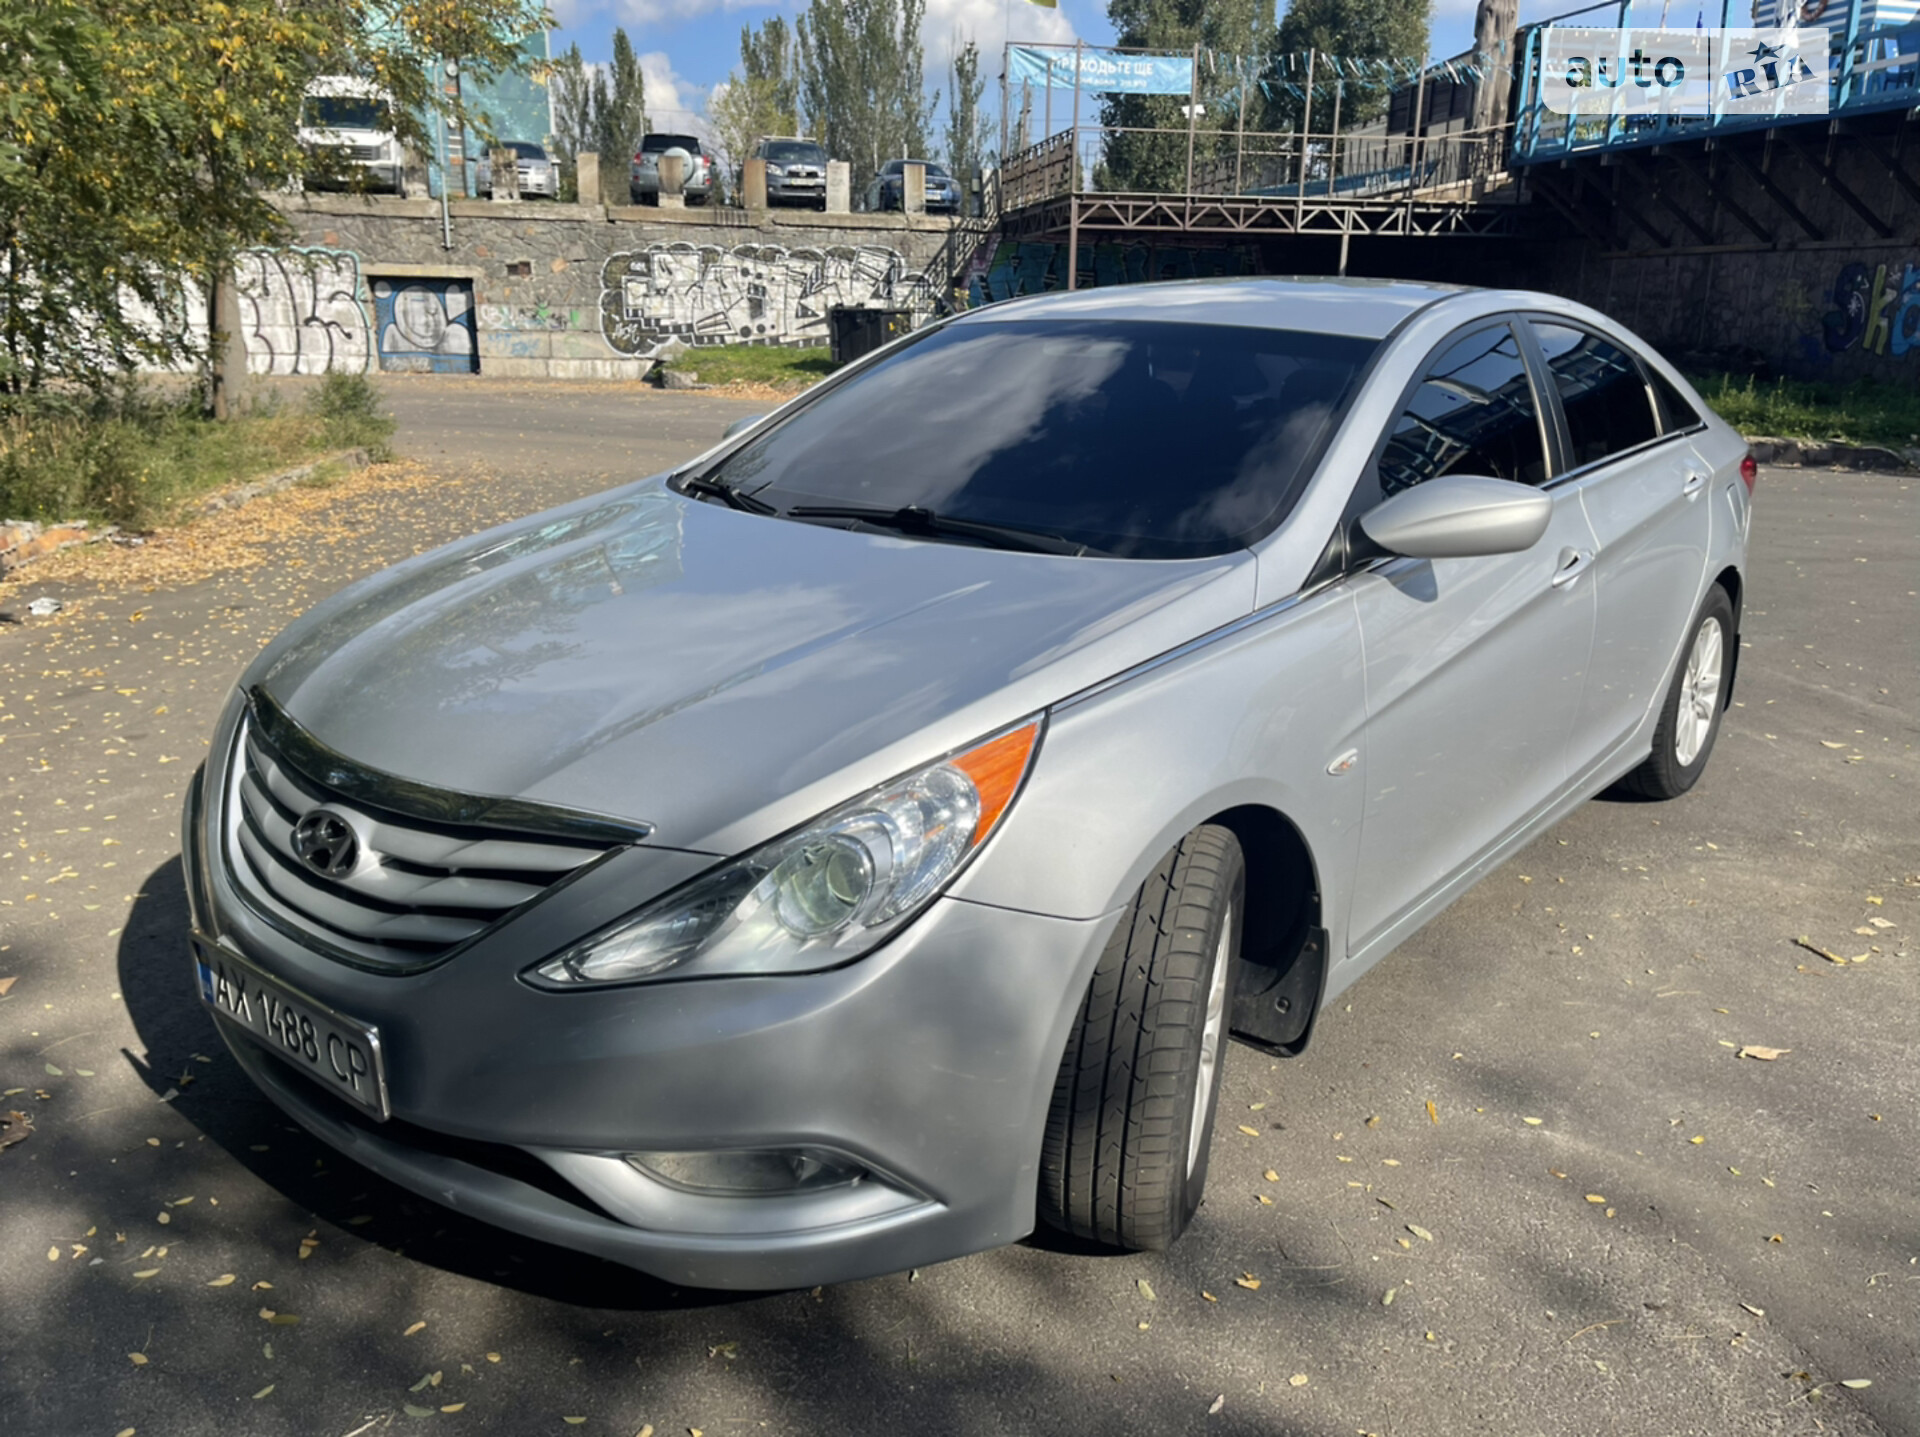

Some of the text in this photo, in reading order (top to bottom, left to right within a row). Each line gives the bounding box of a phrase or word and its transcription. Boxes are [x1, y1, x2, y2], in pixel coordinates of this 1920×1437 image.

[1133, 62, 1153, 76] ЩЕ
[216, 962, 368, 1091] AX 1488 CP
